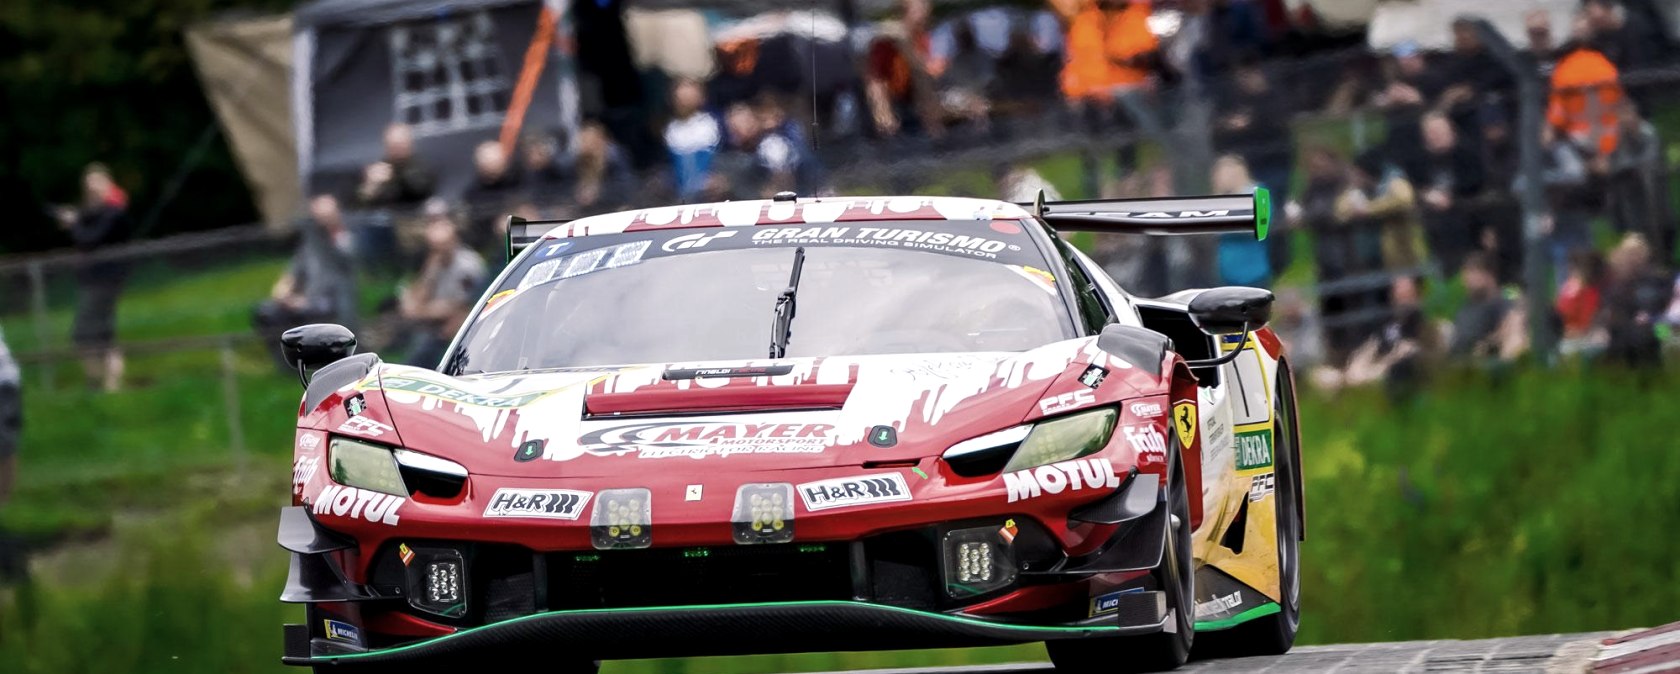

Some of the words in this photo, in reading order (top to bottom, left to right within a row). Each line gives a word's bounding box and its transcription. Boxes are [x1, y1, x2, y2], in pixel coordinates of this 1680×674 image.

[752, 227, 850, 240] GRAN
[833, 238, 899, 247] DRIVING
[903, 242, 997, 259] SIMULATOR
[417, 384, 523, 407] DEKRA
[652, 423, 836, 443] MAYER
[720, 438, 825, 446] MOTORSPORT
[1241, 434, 1271, 466] DEKRA
[1003, 458, 1120, 503] MOTUL
[492, 493, 547, 510] H&R
[806, 482, 865, 502] H&R
[312, 484, 406, 526] MOTUL
